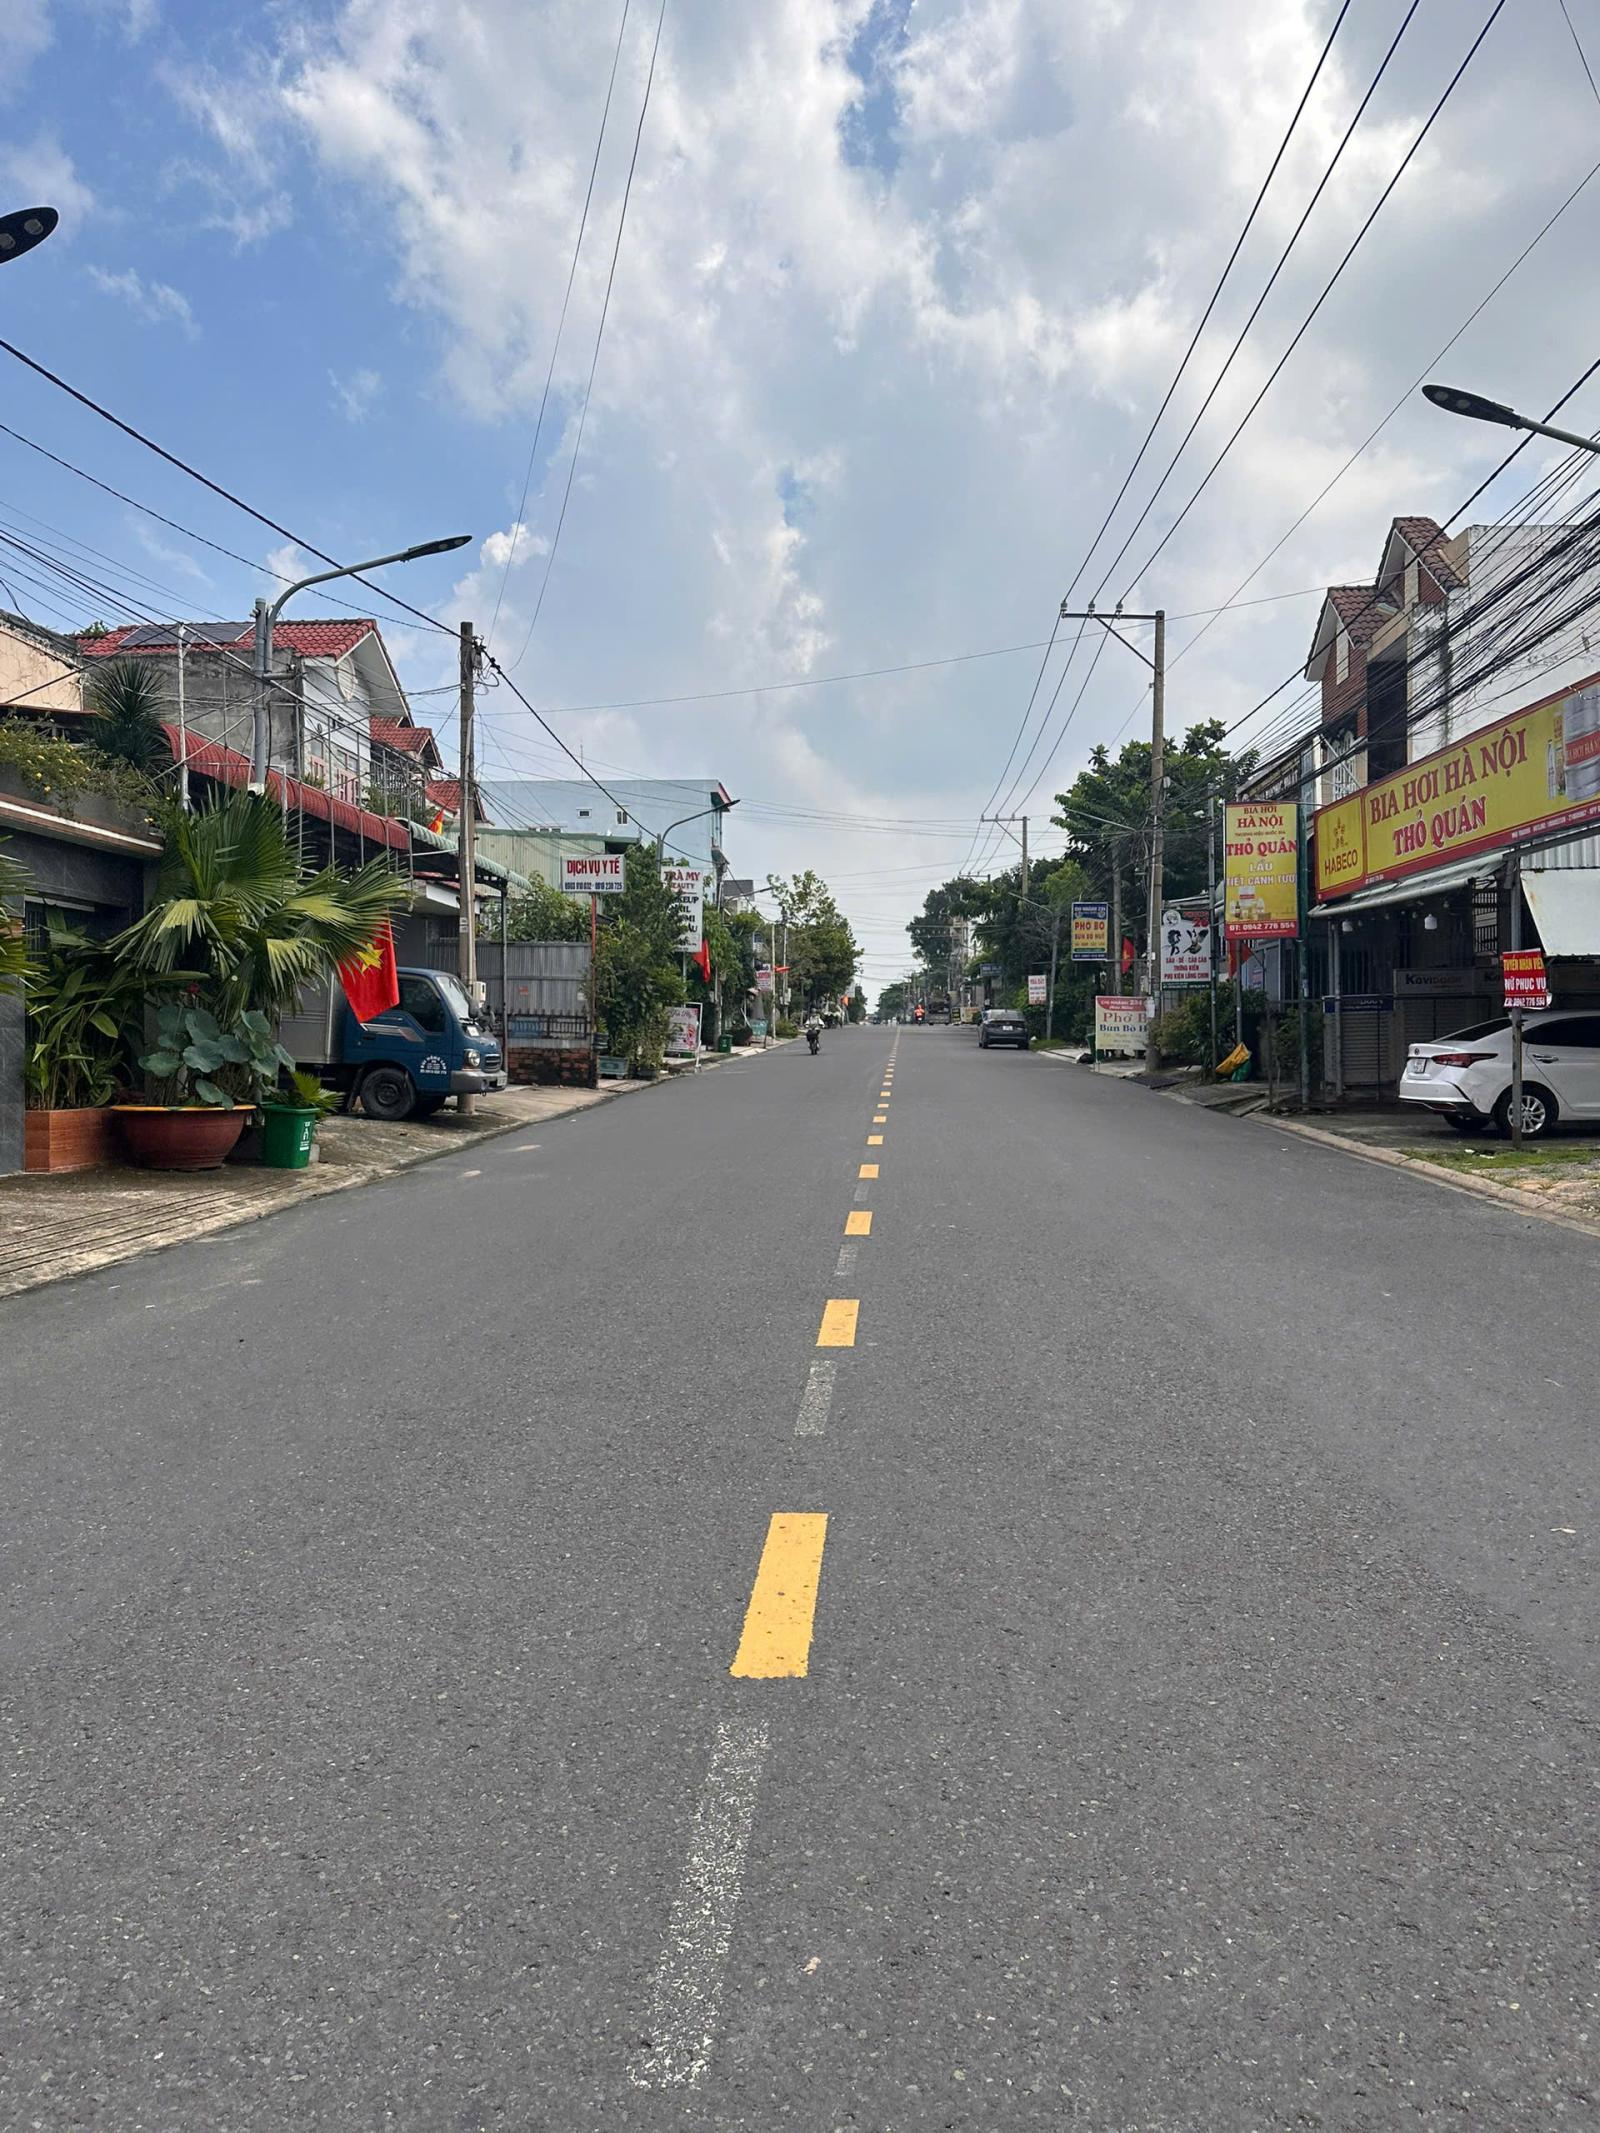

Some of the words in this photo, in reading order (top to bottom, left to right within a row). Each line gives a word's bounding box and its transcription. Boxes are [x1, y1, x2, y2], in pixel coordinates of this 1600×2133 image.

[1370, 790, 1400, 825] BIA
[1402, 768, 1439, 815] HƠI
[1443, 747, 1477, 794] HÀ
[1480, 728, 1528, 778] NỘI
[1237, 815, 1257, 828] HÀ
[1260, 814, 1284, 829] NỘI
[1392, 808, 1427, 857] THỎ
[1430, 795, 1487, 848] QUÁN
[1226, 837, 1254, 856] THỎ
[1257, 837, 1297, 857] QUÁN
[567, 860, 587, 876] DỊCH
[588, 860, 600, 876] VỤ
[602, 860, 608, 874] Y
[609, 856, 620, 874] TẾ
[1324, 848, 1358, 876] HABECO
[664, 869, 684, 881] TRÀ
[686, 872, 701, 881] MY
[1248, 876, 1274, 886] CANH
[675, 896, 699, 904] KEUP
[1516, 977, 1535, 993] PHỤC
[1536, 977, 1547, 993] VỤ
[1103, 1012, 1133, 1022] Phở
